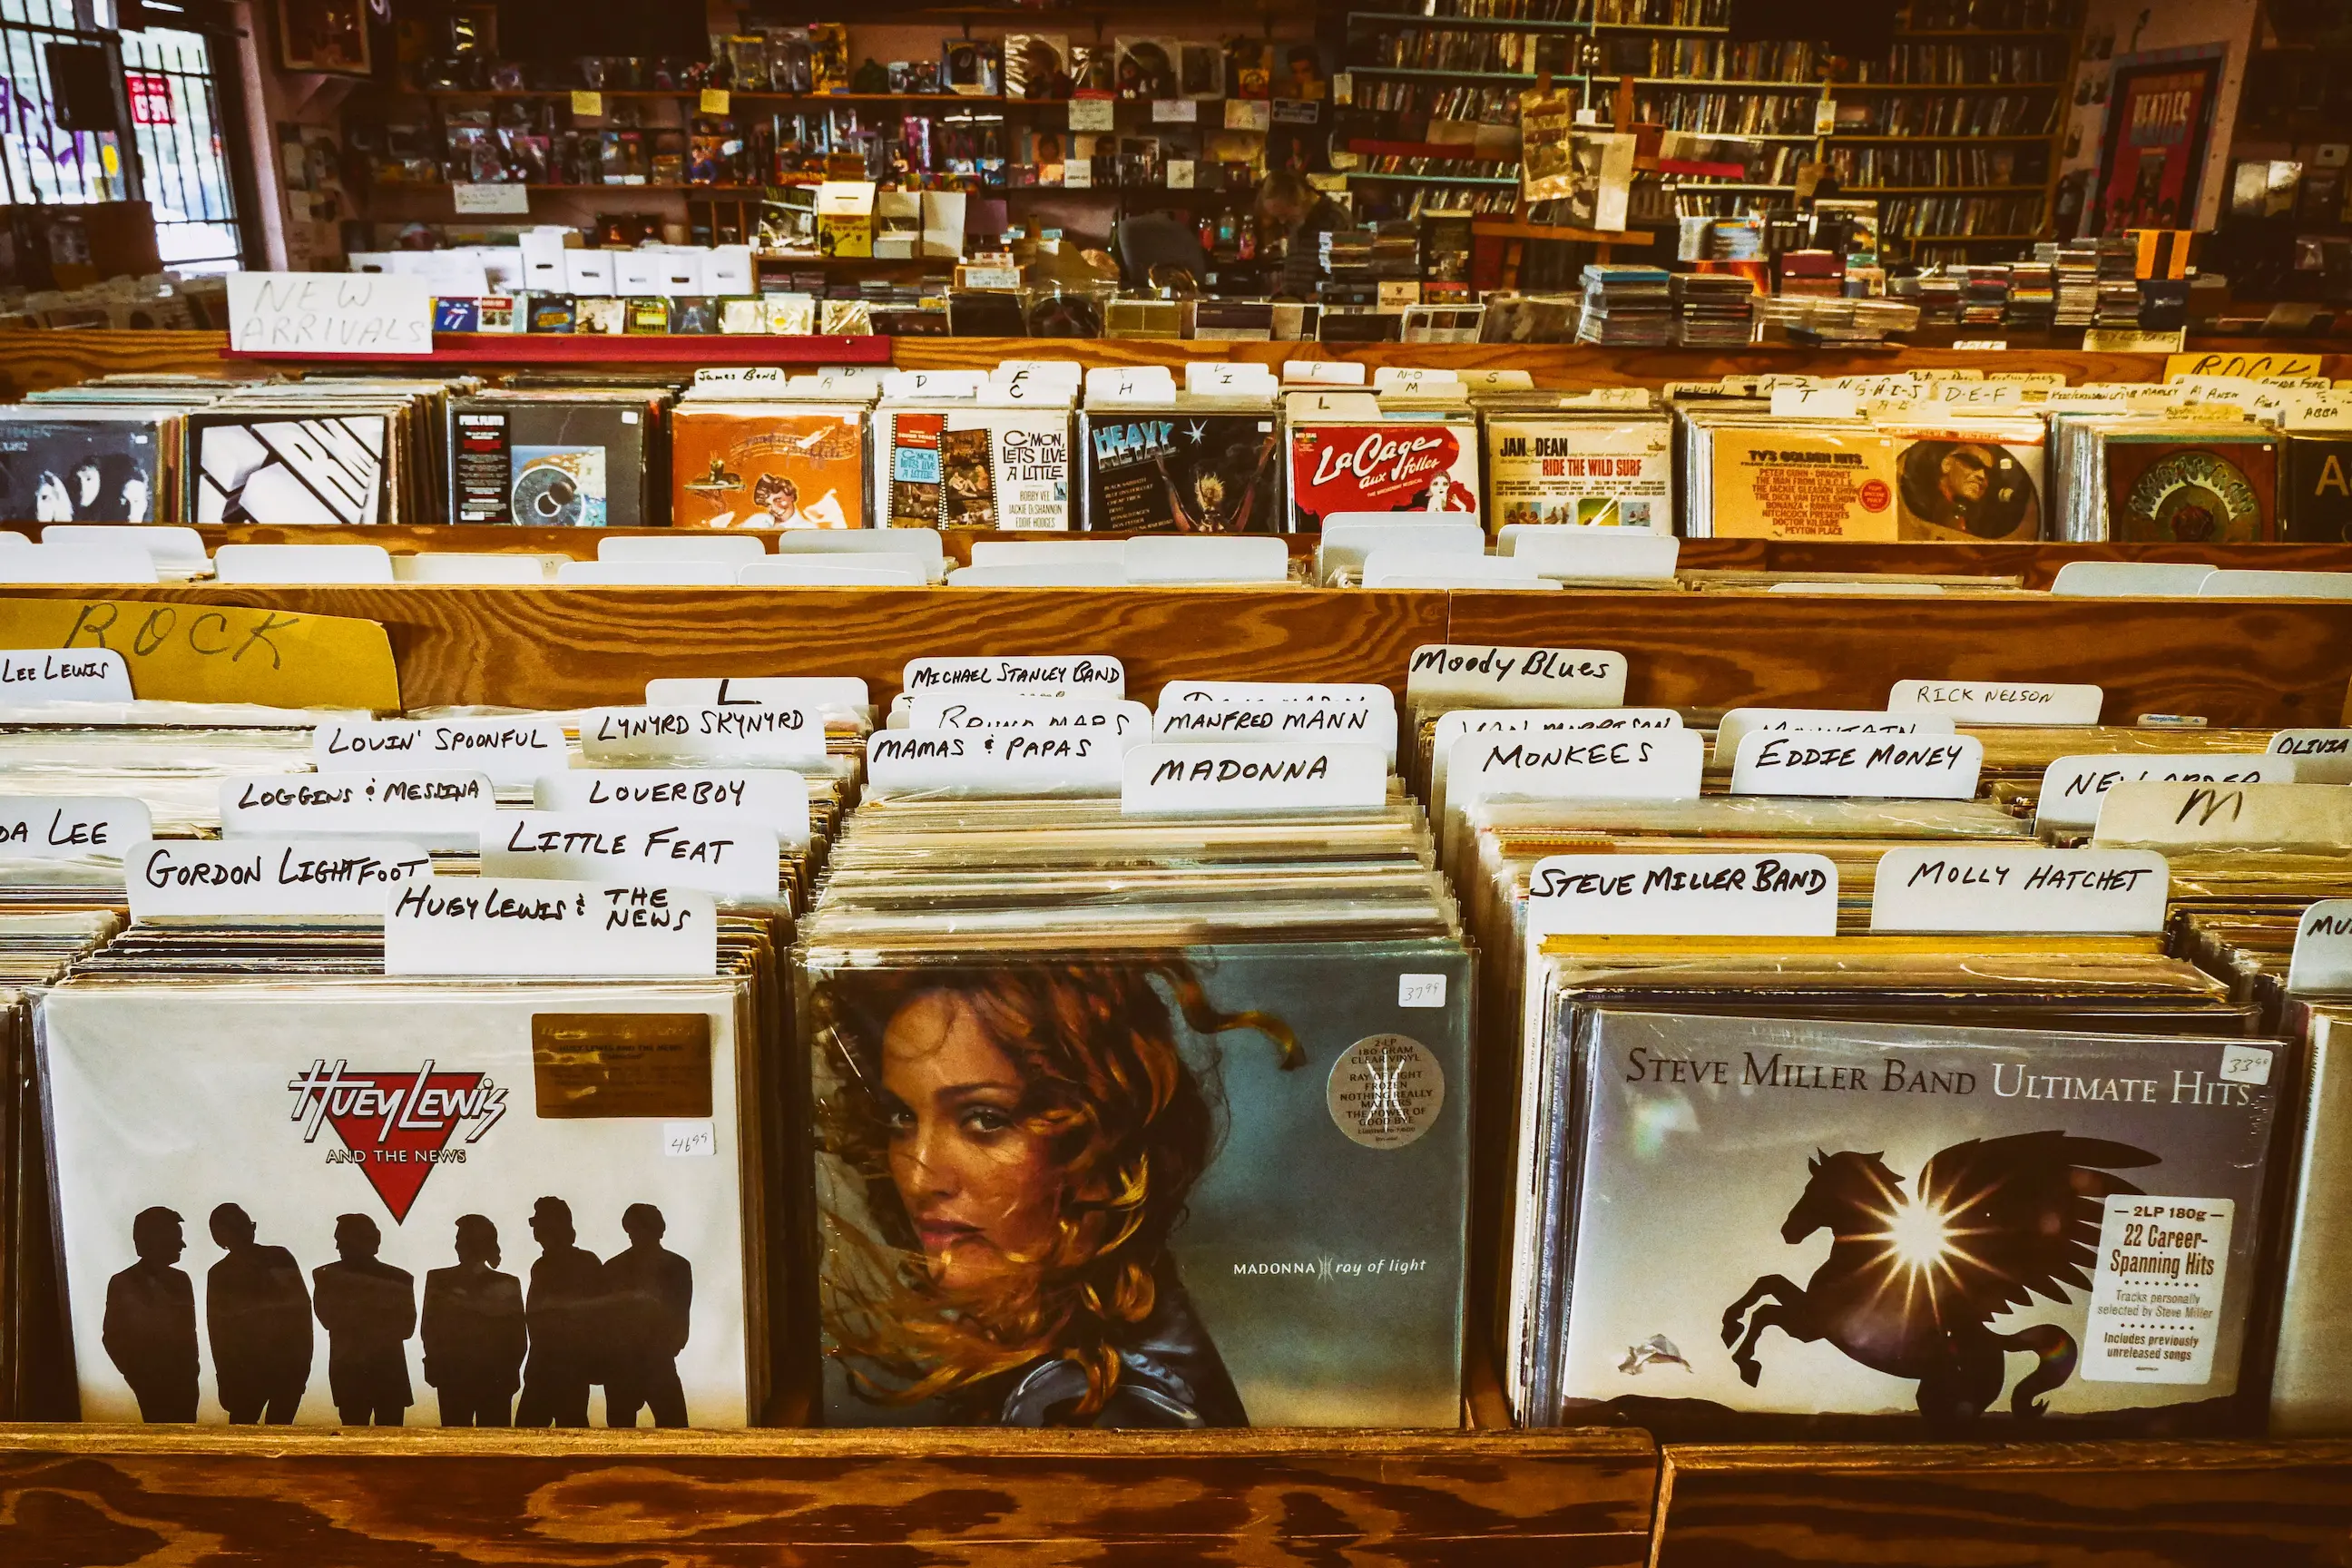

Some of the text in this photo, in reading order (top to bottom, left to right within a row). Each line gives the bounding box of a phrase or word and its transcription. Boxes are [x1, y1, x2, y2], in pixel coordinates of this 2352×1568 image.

[253, 279, 373, 313] NEW
[239, 314, 426, 352] ARRIVALS
[699, 369, 736, 382] James
[1311, 363, 1322, 377] P
[1486, 372, 1498, 383] S
[916, 375, 928, 388] D
[1119, 383, 1133, 396] H
[1406, 382, 1418, 393] M
[1318, 397, 1331, 410] L
[1800, 389, 1818, 403] T
[2304, 407, 2338, 419] ABBA
[1093, 420, 1175, 456] HEAVY
[1500, 437, 1526, 456] JAN
[1534, 437, 1569, 456] DEAN
[1041, 447, 1067, 464] LIVE
[1098, 444, 1178, 471] METAL
[1312, 433, 1443, 486] La Cage
[1006, 465, 1063, 481] A LITTLE
[1358, 455, 1441, 490] aux folles
[1543, 458, 1642, 476] RIDE THE WILD SURF
[1759, 468, 1785, 477] PETER
[1019, 490, 1051, 502] BOBBY VEE
[1752, 485, 1768, 493] THE
[1008, 504, 1027, 514] JACKIE
[1761, 510, 1809, 518] HITCHCOCK
[1766, 502, 1803, 510] BONANZA
[1015, 516, 1056, 528] EDDIE HODGES
[1772, 517, 1805, 526] DOCTOR
[1785, 526, 1844, 536] PEYTON PLACE
[64, 601, 300, 670] ROCK
[2, 654, 109, 682] LEE LEWIS
[911, 659, 1121, 689] MICHAEL STANLEY BAND
[1411, 648, 1611, 682] Moody Blues
[716, 679, 763, 705] L
[1916, 684, 2056, 705] RICK NELSON
[597, 709, 805, 741] LYNYRD SKYNYRD
[1163, 709, 1369, 731] MANFRED MANN
[328, 727, 548, 755] LOVIN' SPOONFUL
[872, 738, 965, 763] MAMAS
[1005, 736, 1092, 760] PAPAS
[2276, 737, 2351, 755] OLIVIA
[1482, 743, 1654, 773] MONKEES
[1755, 738, 1964, 770] EDDIE MONEY
[1150, 755, 1328, 786] MADONNA
[238, 782, 354, 809] LOGGINS
[383, 779, 480, 803] MESSINA
[588, 780, 746, 807] LOVERBOY
[2174, 788, 2244, 828] M
[48, 808, 108, 846] LEE
[507, 820, 734, 865] LITTLE FEAT
[145, 847, 429, 887] GORDON LIGHTFOOT
[1529, 858, 1828, 898] STEVE MILLER BAND
[1906, 861, 2153, 892] MOLLY HATCHET
[395, 884, 479, 919] HUEY
[485, 887, 567, 921] LEWIS
[603, 887, 669, 907] THE
[605, 909, 691, 931] NEWS
[1351, 1053, 1422, 1064] CLEAR VINYL
[1349, 1072, 1370, 1083] RAY
[1391, 1070, 1424, 1081] LIGHT
[1625, 1046, 2252, 1109] STEVE MILLER BAND ULTIMATE HITS
[1339, 1089, 1434, 1102] NOTHING REALLY
[1365, 1081, 1408, 1092] FROZEN
[1360, 1098, 1413, 1109] MATTERS
[1347, 1106, 1427, 1120] THE POWER OF
[325, 1148, 467, 1164] AND THE NEWS
[2133, 1205, 2208, 1222] 2LP 180g
[2123, 1223, 2209, 1250] 22 Career-
[1233, 1257, 1427, 1277] MADONNA ray of light
[2110, 1249, 2215, 1279] Spanning Hits
[2116, 1289, 2201, 1306] Tracks personally
[2097, 1303, 2214, 1319] selected by Steve Miller
[2103, 1331, 2200, 1348] Includes previously
[2107, 1347, 2192, 1362] unreleased songs
